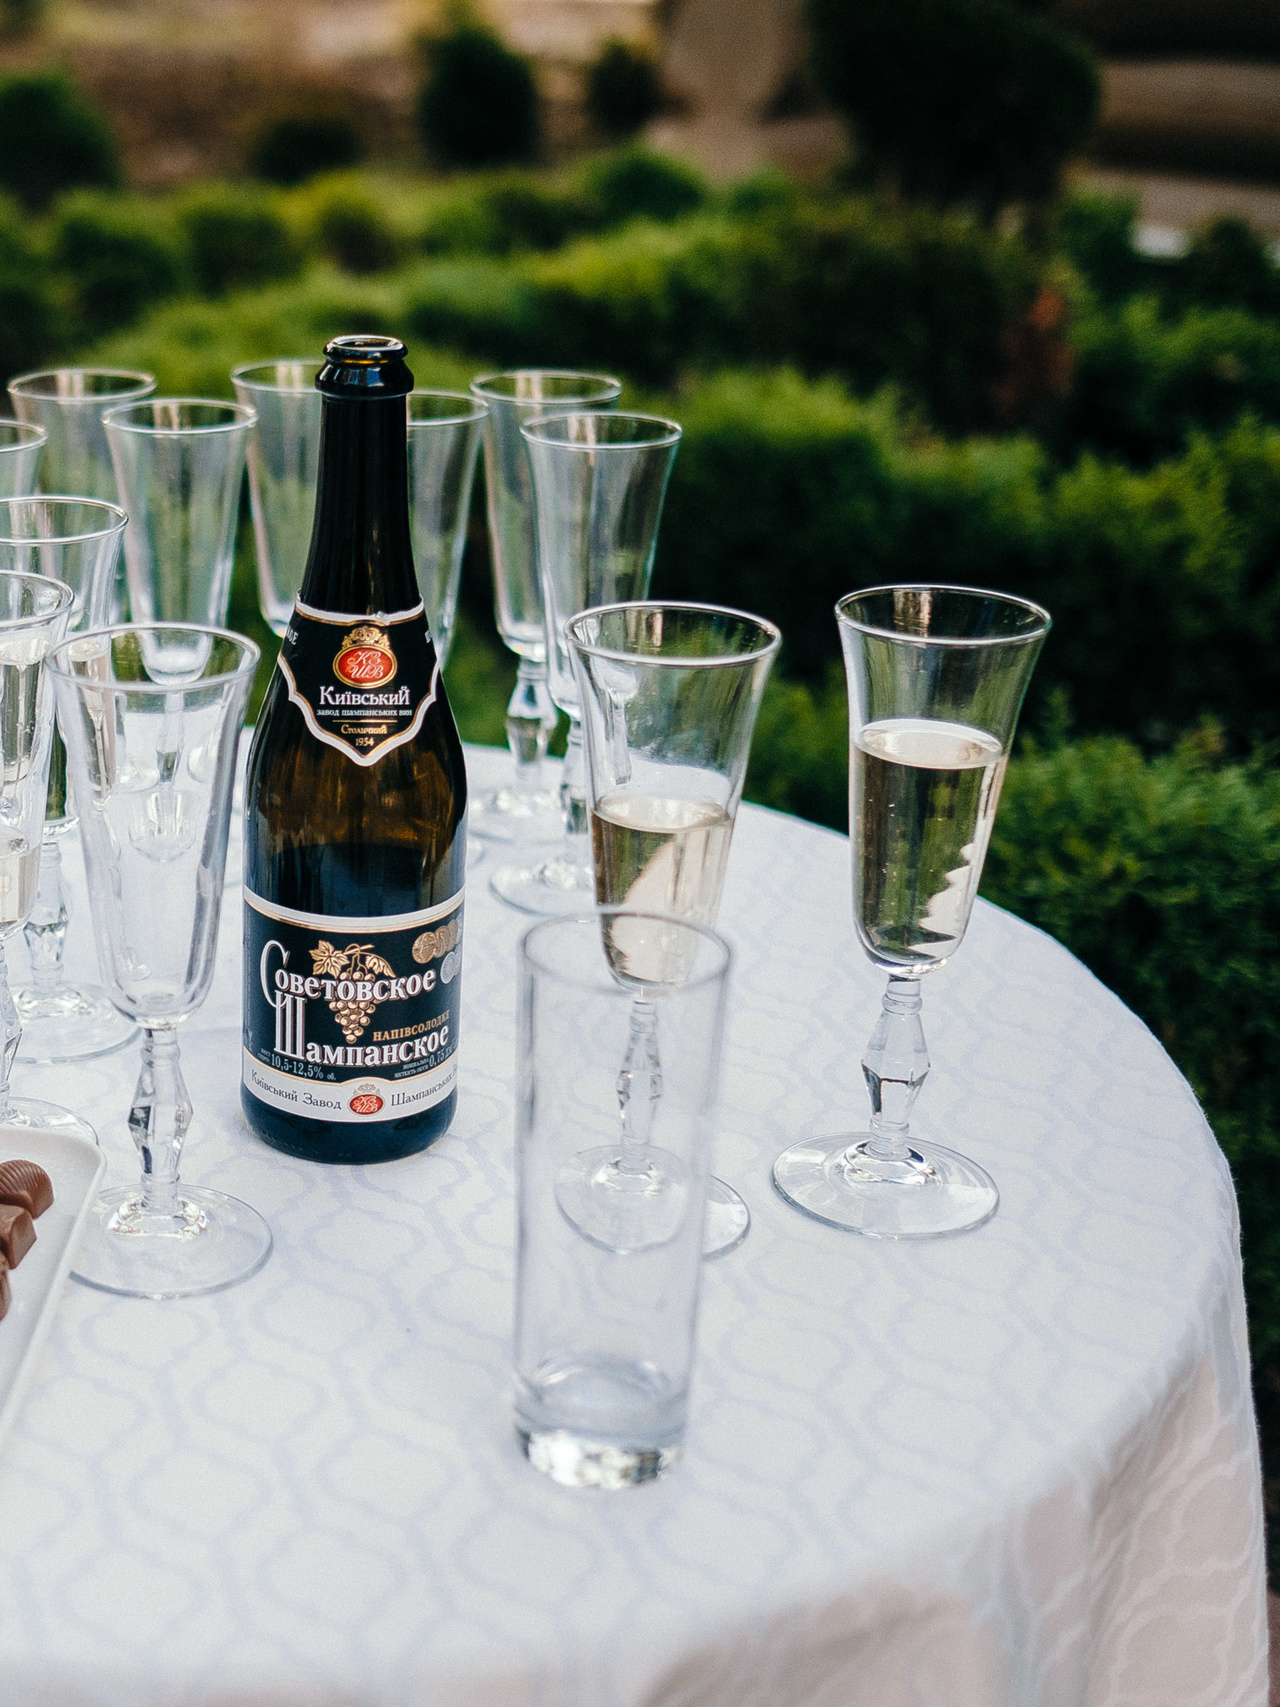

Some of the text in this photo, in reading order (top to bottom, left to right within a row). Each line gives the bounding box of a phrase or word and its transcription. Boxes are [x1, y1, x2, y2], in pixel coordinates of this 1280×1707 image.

[355, 737, 375, 746] 1954
[260, 940, 437, 1008] Советовское
[273, 990, 450, 1068] Шампанское
[373, 1009, 450, 1041] НАПІВСОЛОДКЕ
[271, 1054, 324, 1079] 10,5-12,5%
[251, 1069, 298, 1102] Київський
[302, 1092, 342, 1110] Завод
